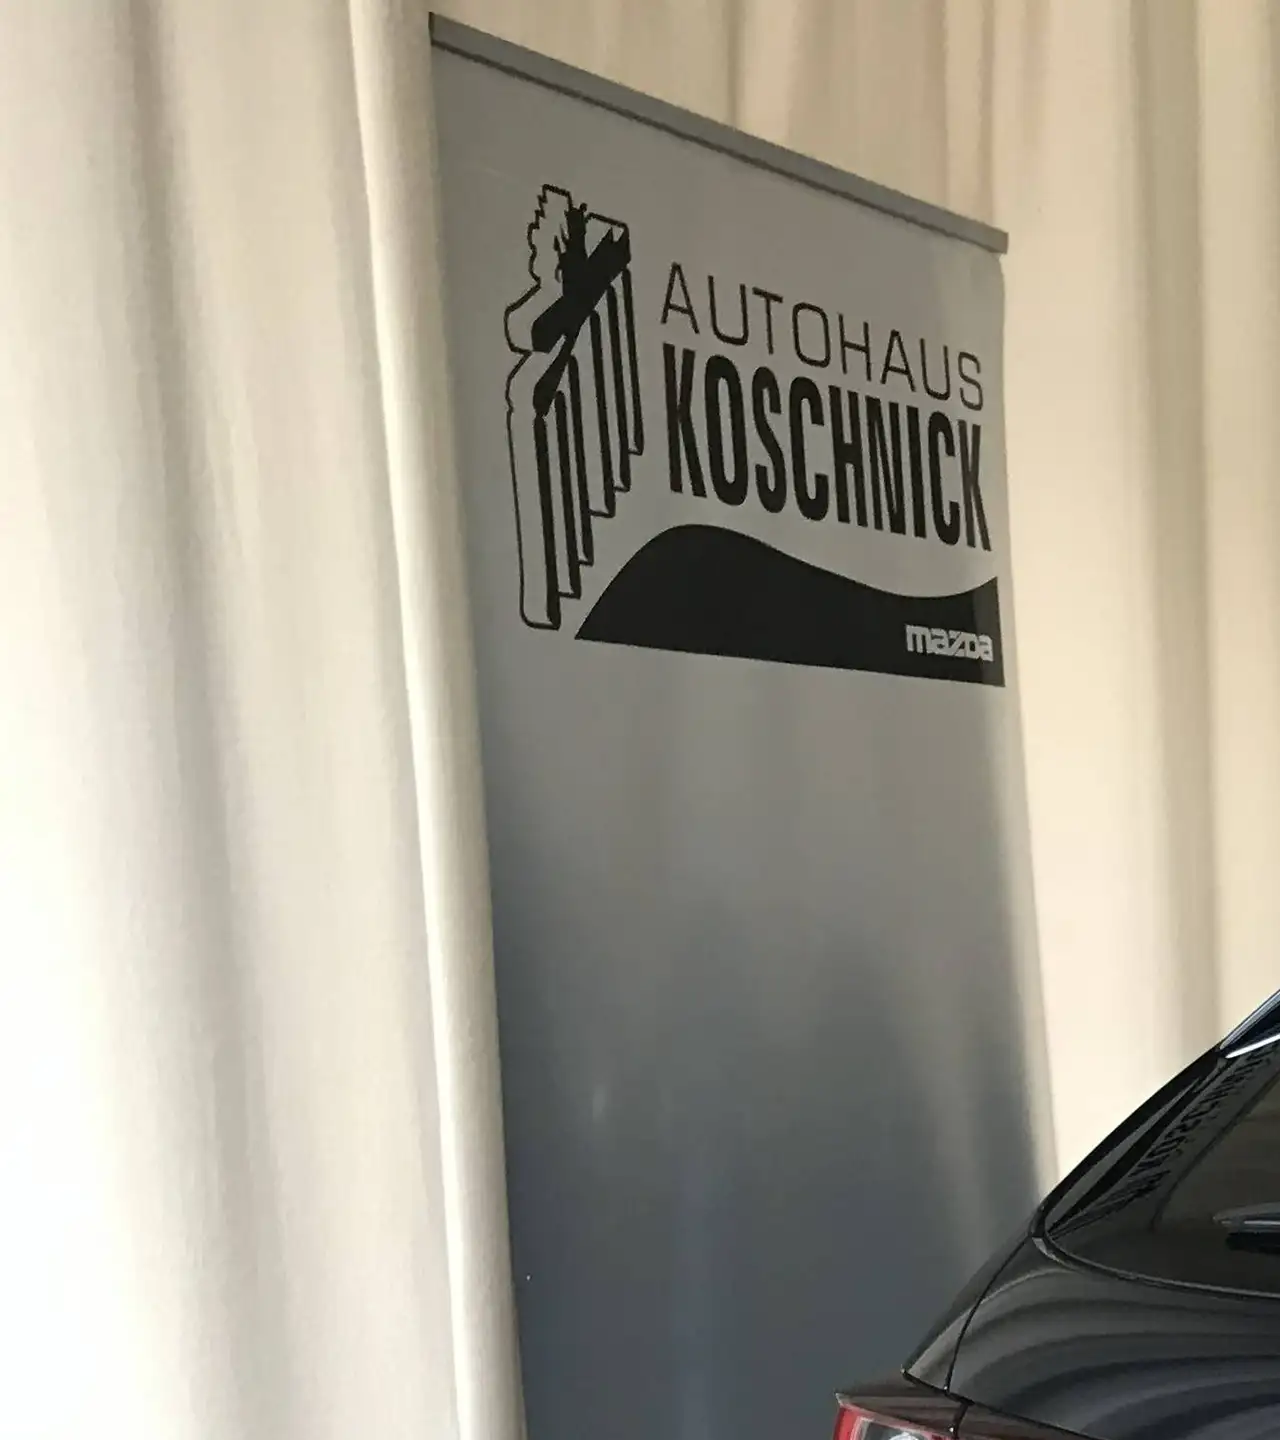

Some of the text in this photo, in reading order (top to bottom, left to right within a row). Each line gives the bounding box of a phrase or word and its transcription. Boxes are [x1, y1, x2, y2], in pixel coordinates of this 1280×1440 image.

[660, 262, 984, 411] AUTOHAUS
[662, 342, 992, 552] KOSCHNICK
[905, 624, 994, 663] mazda
